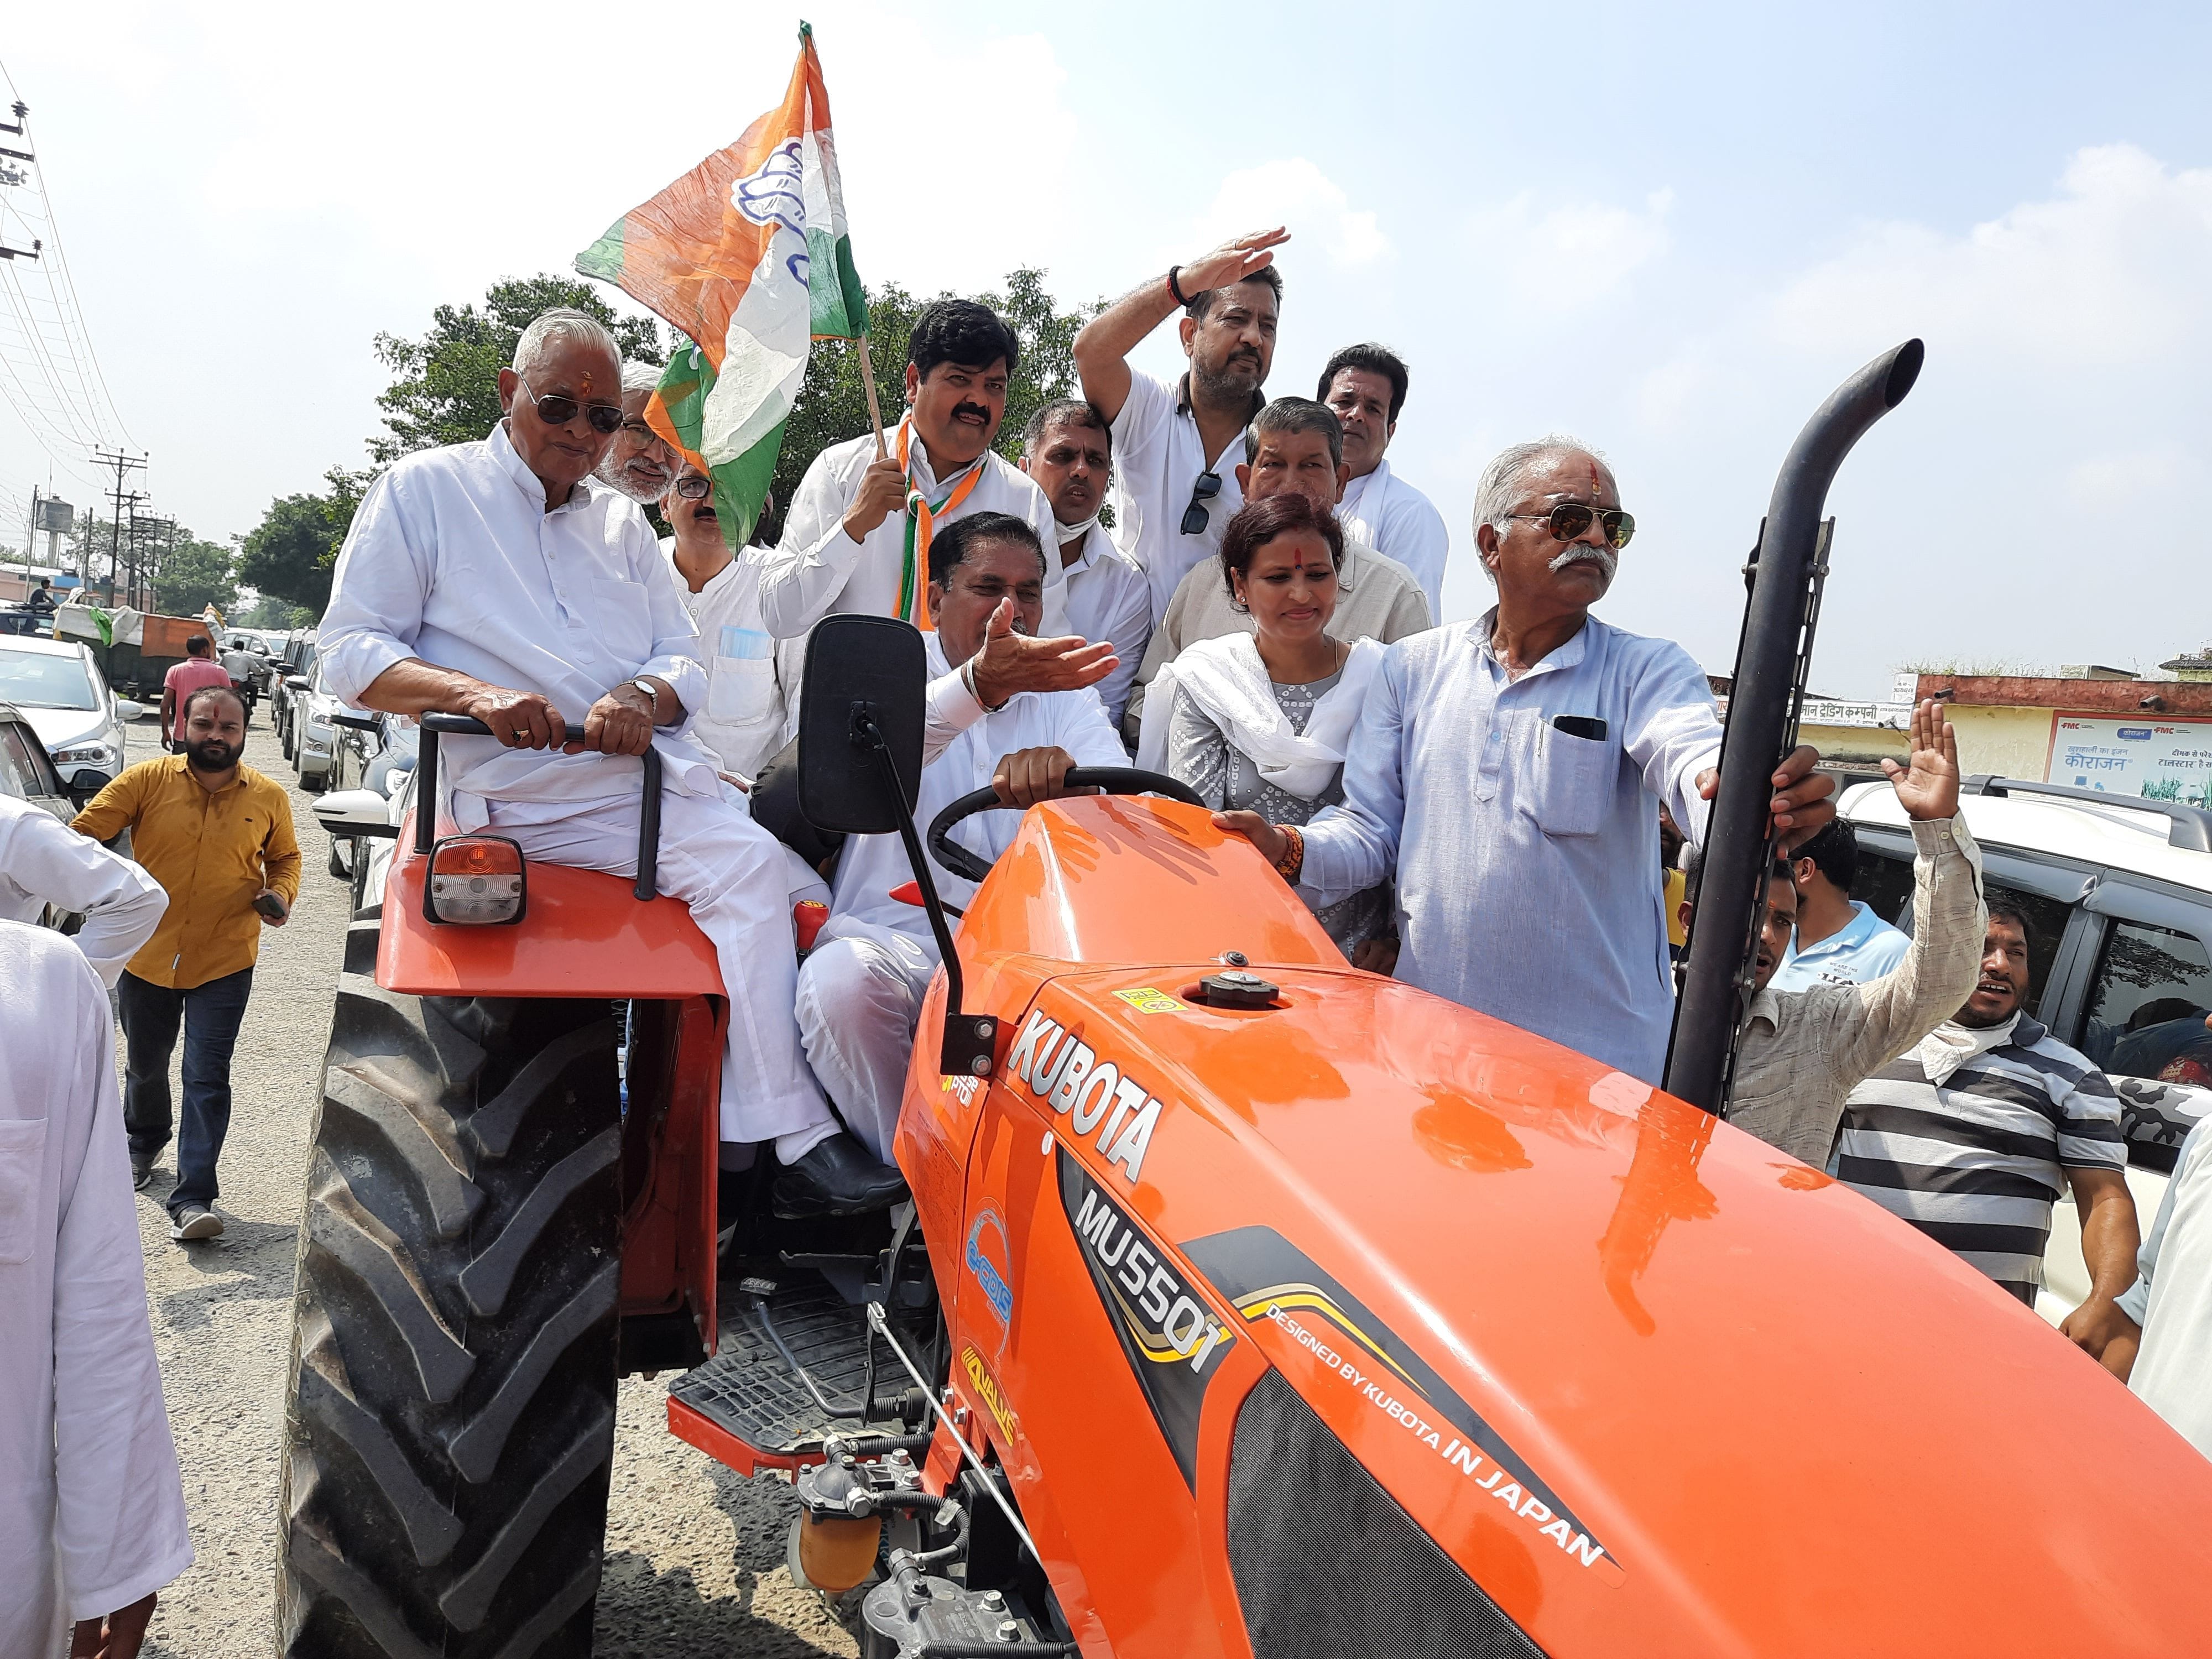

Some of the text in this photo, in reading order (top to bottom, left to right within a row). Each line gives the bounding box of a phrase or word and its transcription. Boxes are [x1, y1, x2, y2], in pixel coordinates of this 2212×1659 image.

[1845, 705, 1877, 718] कम्पनी
[2068, 745, 2097, 754] खुशहाली
[2111, 747, 2129, 755] इंजन
[1008, 1008, 1164, 1183] KUBOTA
[1074, 1188, 1222, 1374] MU5501
[1265, 1302, 1605, 1568] DESIGNED BY KUBOTA IN JAPAN
